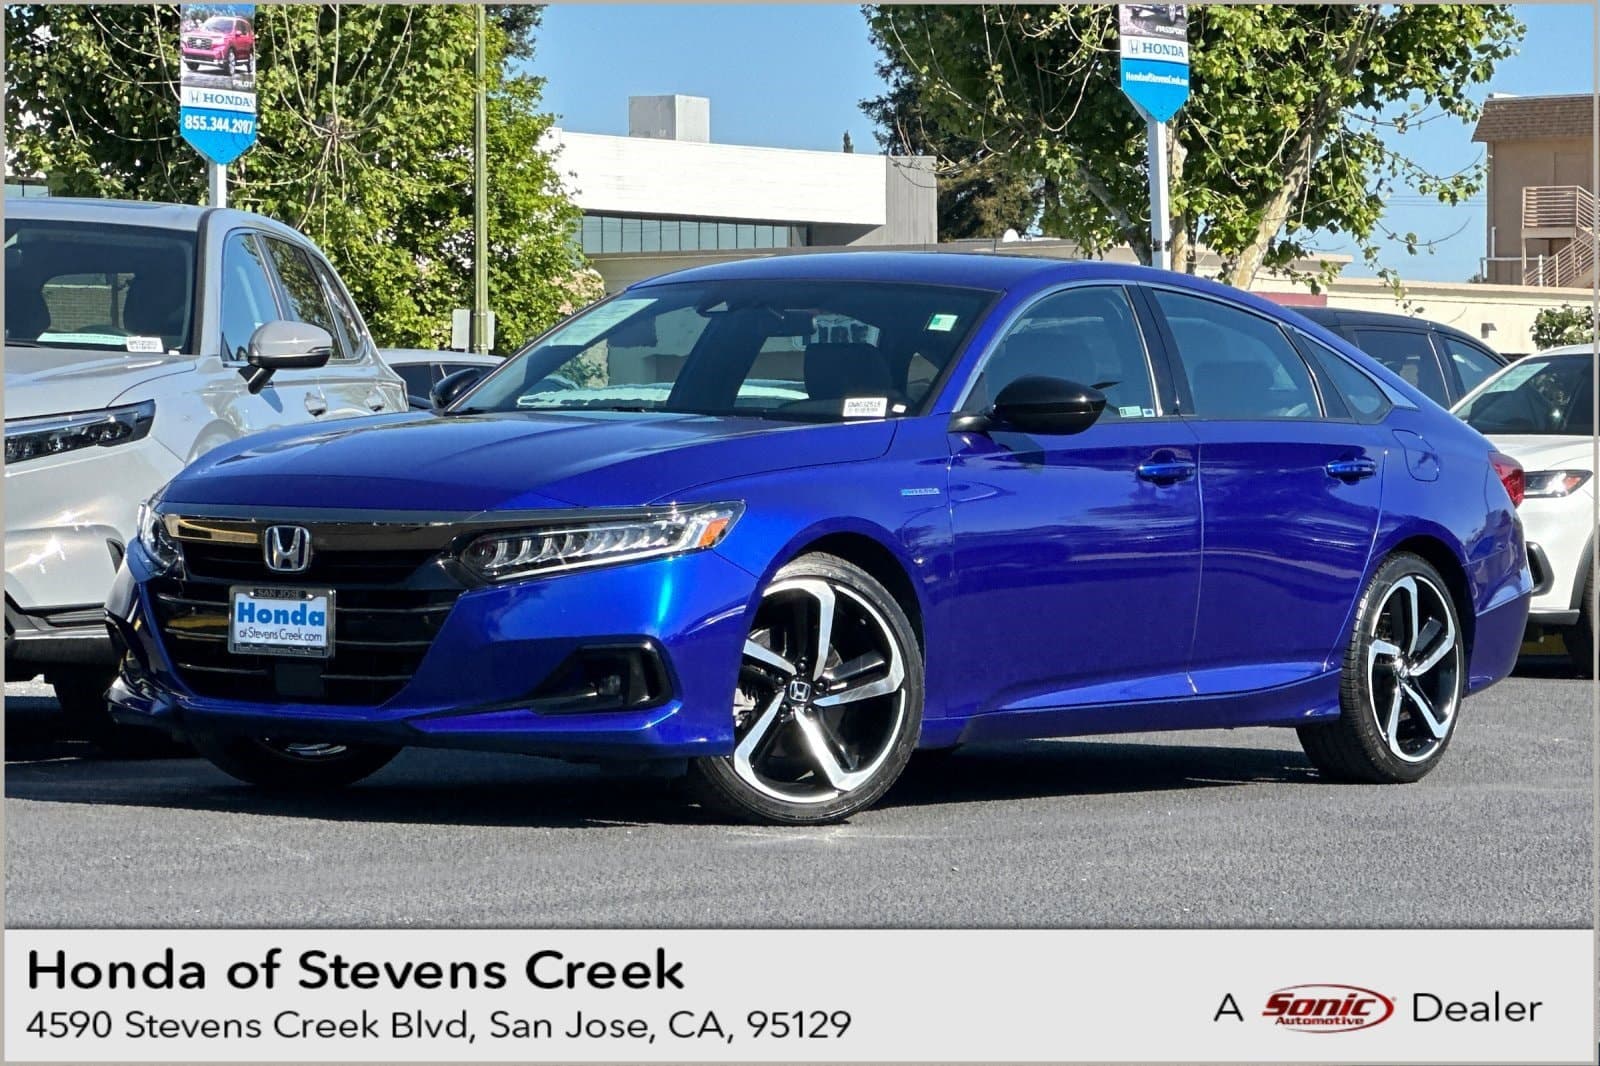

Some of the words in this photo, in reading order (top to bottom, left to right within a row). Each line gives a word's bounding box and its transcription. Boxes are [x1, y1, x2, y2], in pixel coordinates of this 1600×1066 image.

[1142, 43, 1185, 57] HONDA
[203, 93, 252, 106] HONDA
[237, 602, 326, 627] Honda
